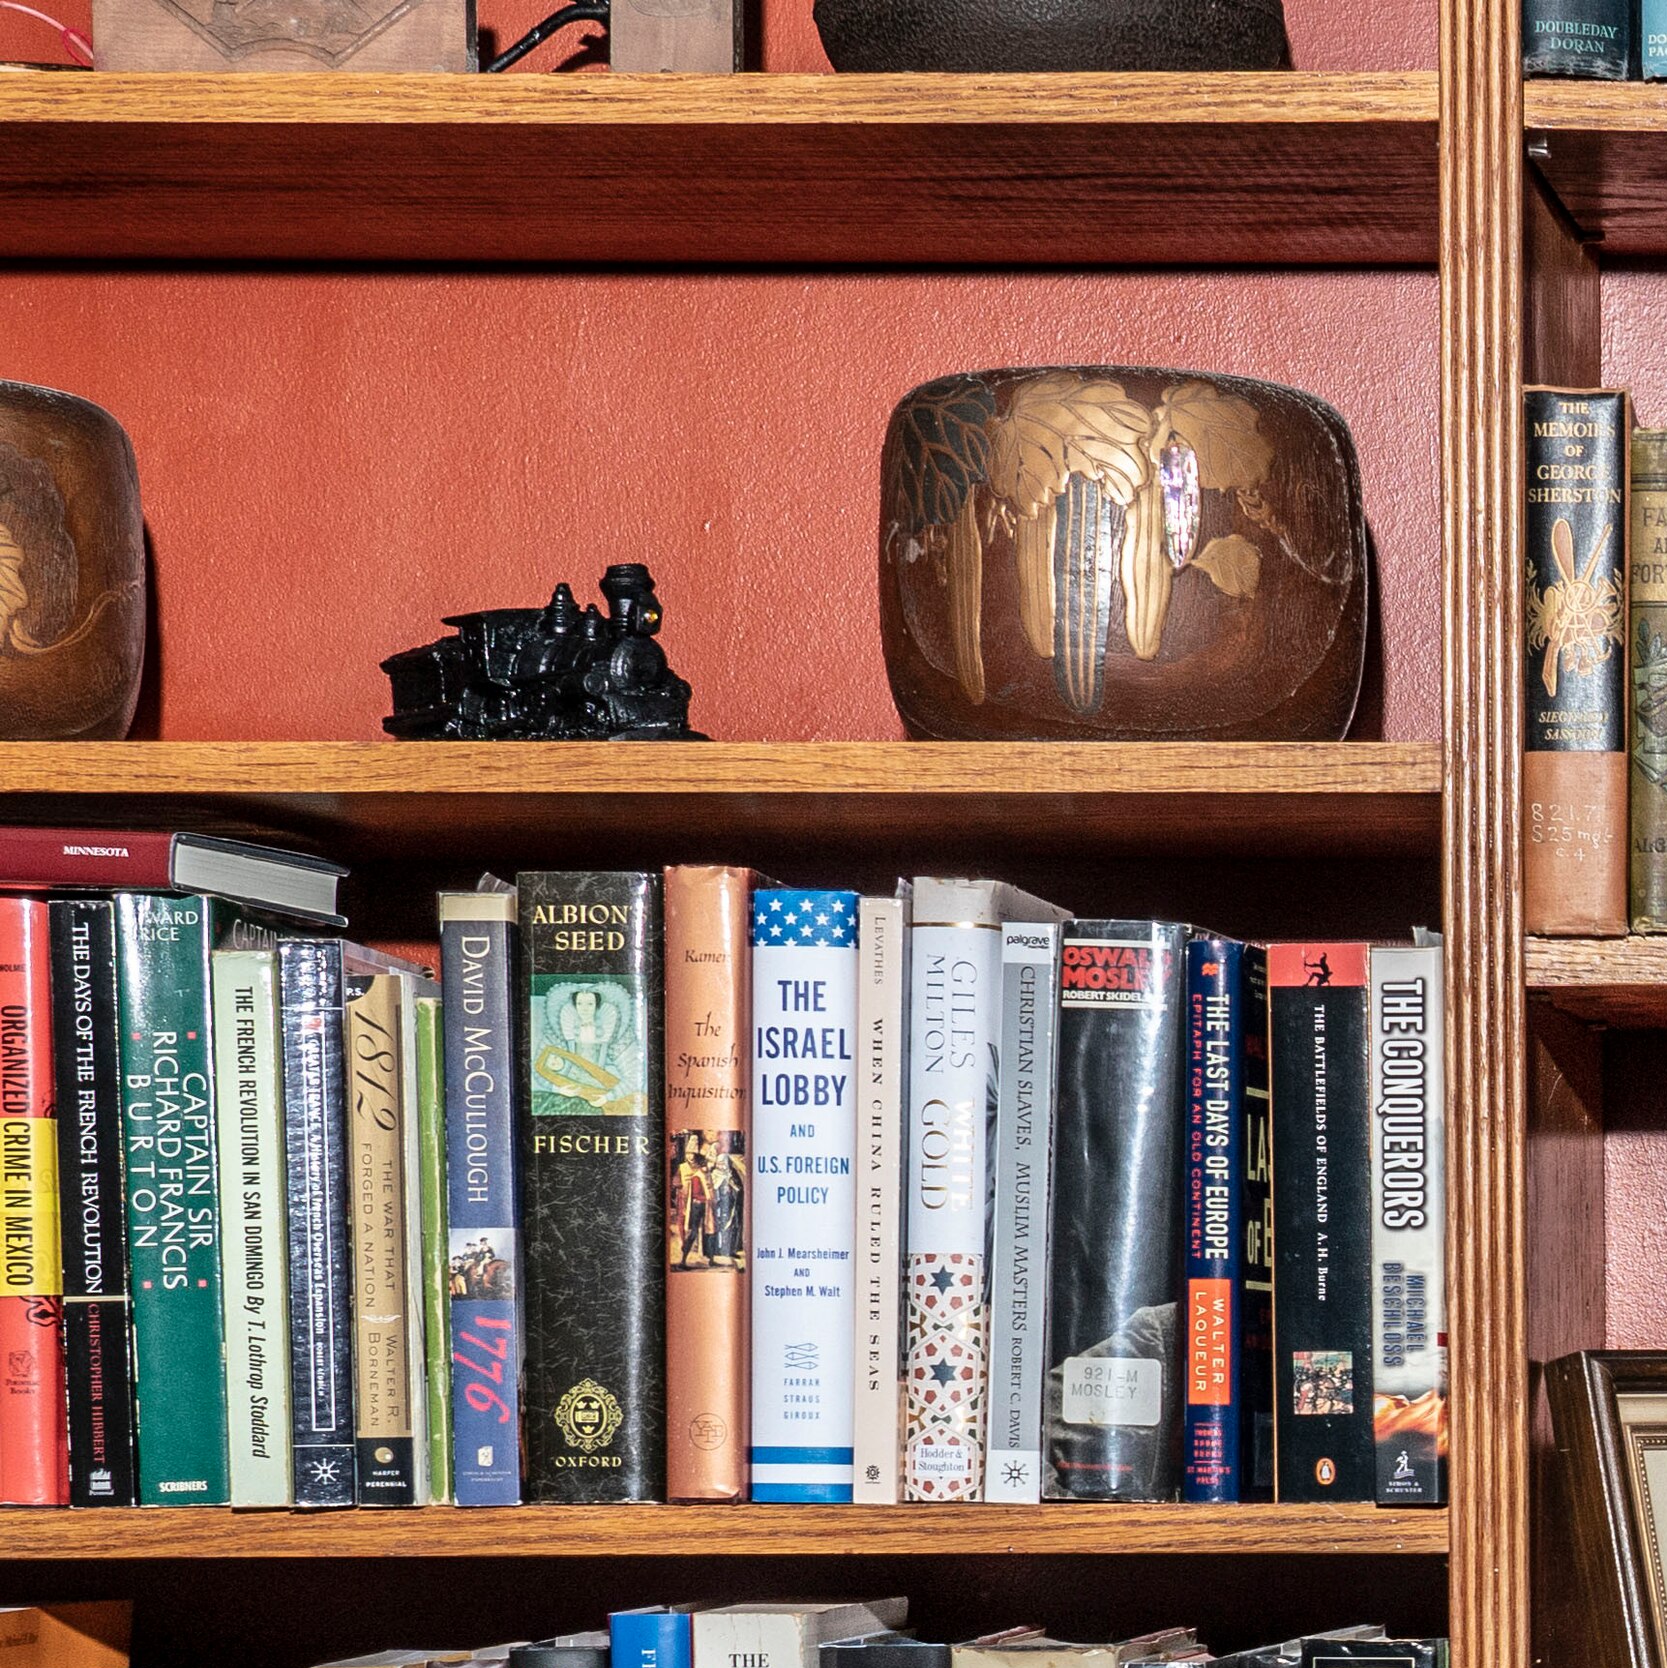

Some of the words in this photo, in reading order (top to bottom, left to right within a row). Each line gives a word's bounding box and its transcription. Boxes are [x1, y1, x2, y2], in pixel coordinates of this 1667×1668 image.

[64, 846, 128, 857] MINNESOTA
[555, 931, 624, 950] SEED
[462, 937, 490, 1014] DAVID
[235, 986, 254, 1013] THE
[778, 980, 826, 1011] THE
[1206, 994, 1230, 1031] THE
[1381, 978, 1425, 1033] THE
[1, 1006, 32, 1113] ORGANIZED
[236, 1019, 256, 1073] FRENCH
[758, 1027, 851, 1059] ISRAEL
[354, 1010, 398, 1131] 1812
[1205, 1041, 1230, 1091] LAST
[153, 1032, 181, 1157] RICHARD
[762, 1074, 846, 1106] LOBBY
[182, 1072, 217, 1194] CAPTAIN
[239, 1080, 259, 1168] REVOLUTION
[790, 1124, 814, 1137] AND
[1205, 1099, 1229, 1147] DAYS
[1376, 1038, 1425, 1230] CONQUERORS
[4, 1122, 31, 1181] CRIME
[127, 1075, 158, 1246] BURTON
[534, 1135, 649, 1155] FISCHER
[243, 1172, 260, 1185] IN
[758, 1156, 781, 1173] U.S.
[787, 1156, 849, 1174] FOREIGN
[1205, 1155, 1229, 1180] OF
[5, 1190, 31, 1207] IN
[244, 1192, 261, 1219] SAN
[778, 1187, 828, 1204] POLICY
[159, 1169, 187, 1289] FRANCIS
[188, 1209, 212, 1248] SIR
[1205, 1185, 1229, 1260] EUROPE
[5, 1217, 33, 1285] MEXICO
[245, 1227, 264, 1289] DOMINGO
[757, 1248, 775, 1258] John
[788, 1248, 849, 1260] Mearsheimer
[454, 1315, 512, 1424] 1776
[556, 1456, 621, 1467] OXFORD
[159, 1481, 207, 1492] SCRIBNERS
[729, 1654, 765, 1667] THE
